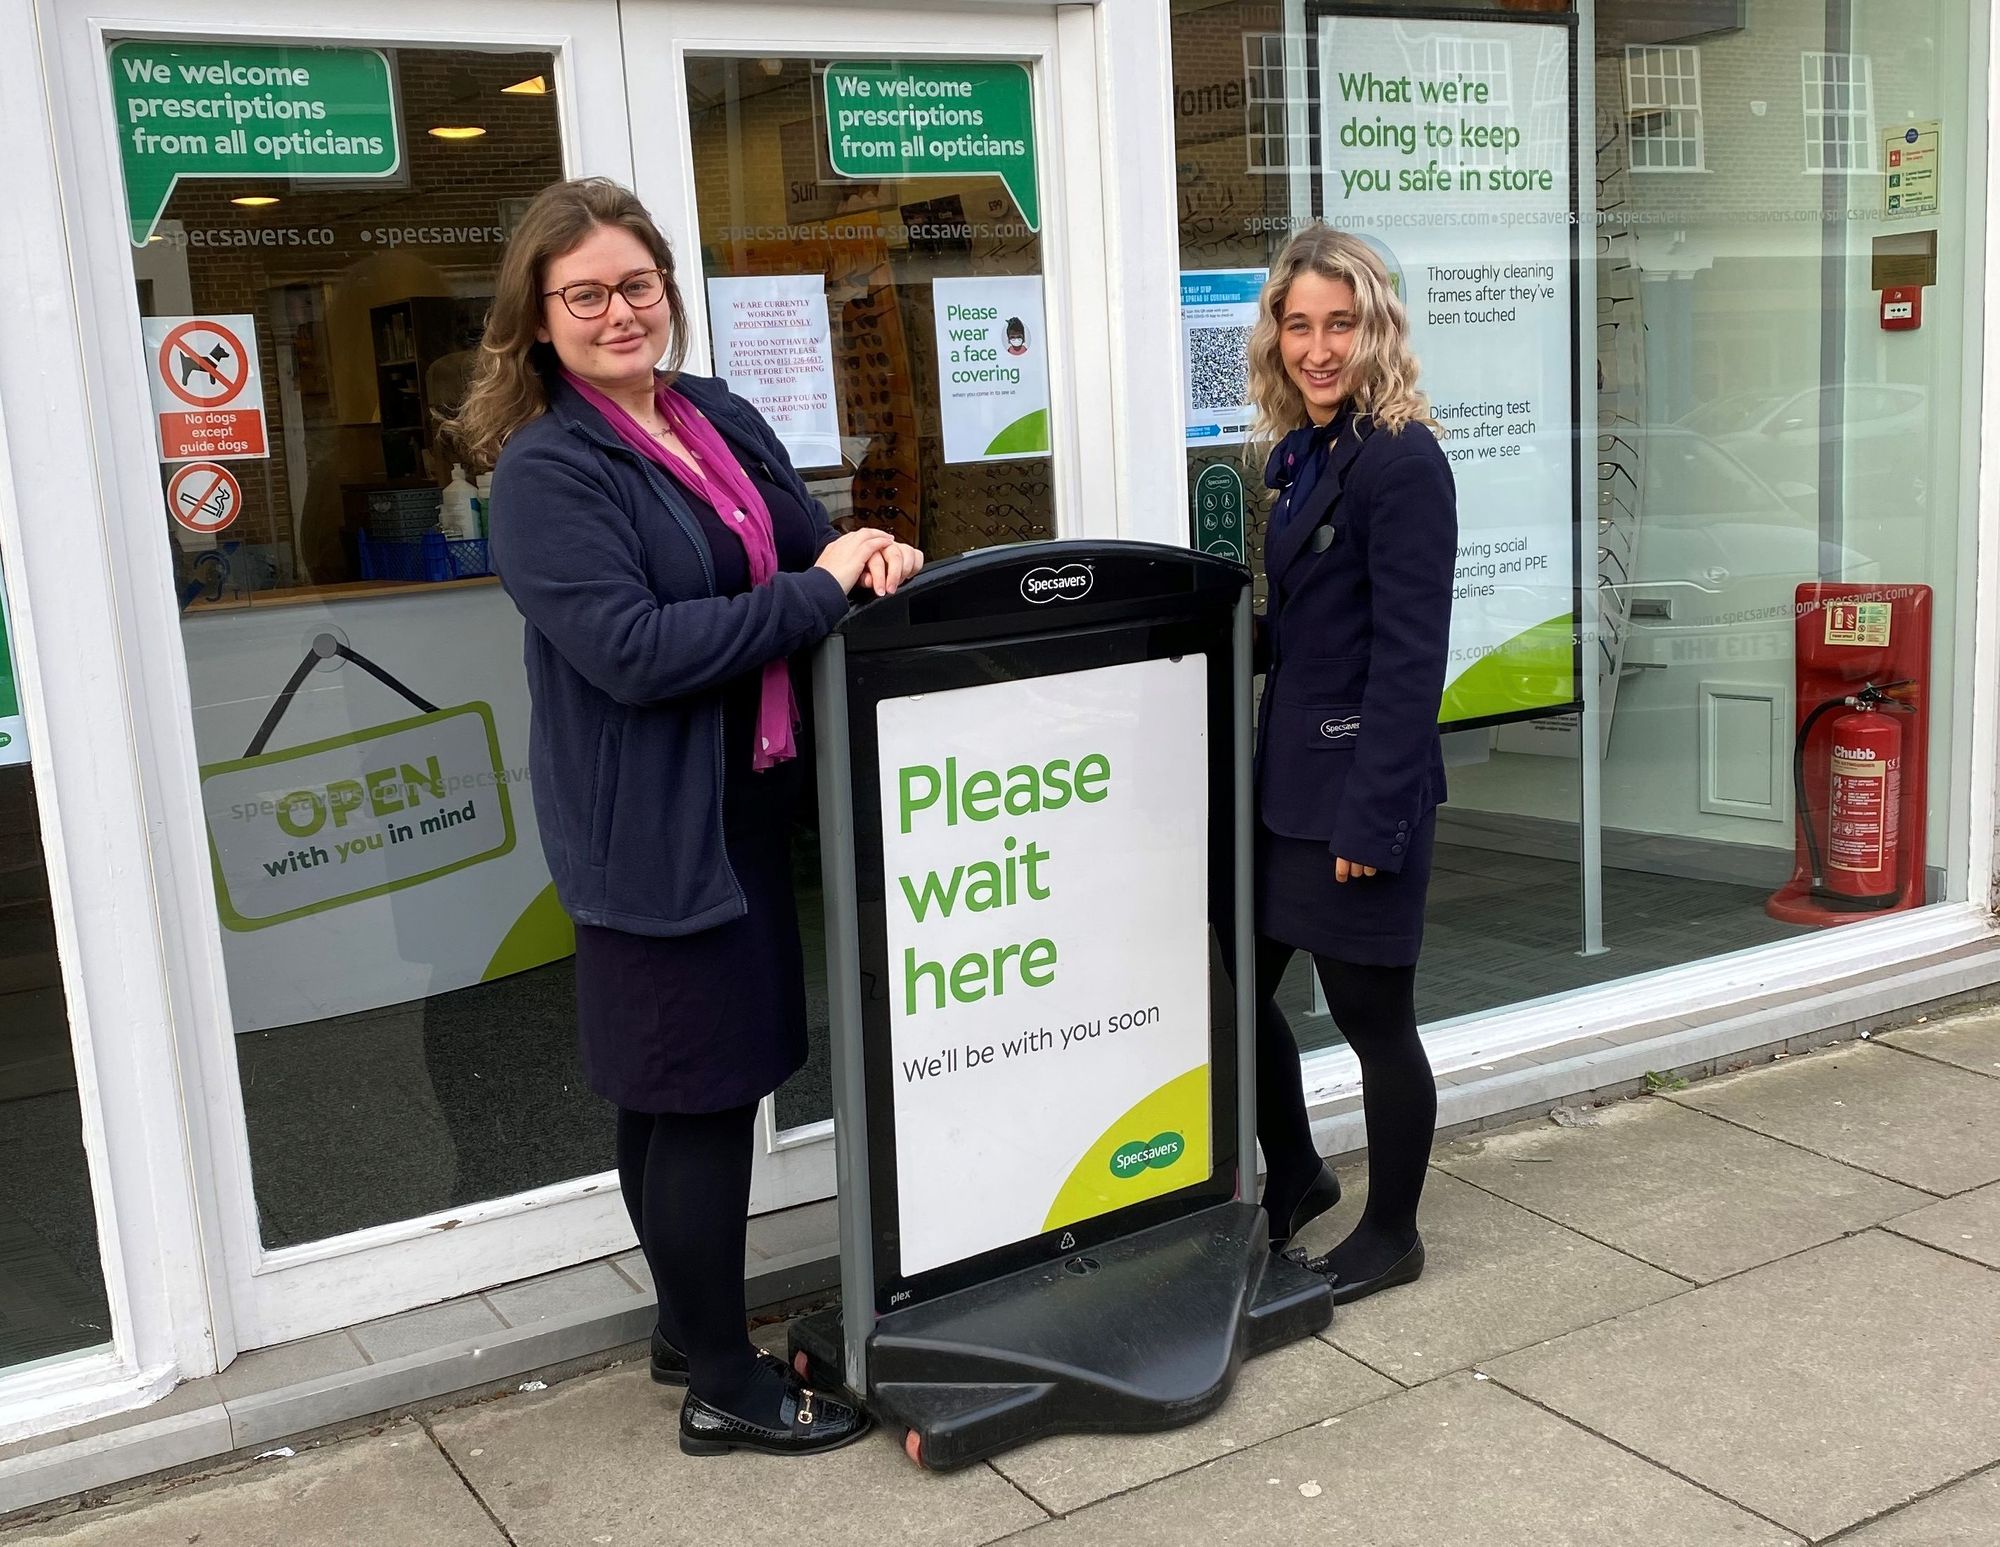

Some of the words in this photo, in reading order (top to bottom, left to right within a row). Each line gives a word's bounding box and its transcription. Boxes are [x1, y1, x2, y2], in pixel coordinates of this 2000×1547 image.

[122, 58, 171, 84] We
[178, 59, 310, 87] welcome
[835, 76, 871, 97] We
[876, 76, 972, 98] welcome
[1175, 76, 1258, 118] omen
[1338, 72, 1412, 104] What
[1418, 73, 1489, 104] we're
[127, 92, 326, 125] prescriptions
[838, 104, 984, 131] prescriptions
[132, 127, 208, 156] from
[214, 128, 248, 155] all
[254, 129, 384, 160] opticians
[1339, 116, 1417, 155] doing
[1423, 120, 1453, 150] to
[1459, 118, 1520, 155] keep
[841, 136, 896, 159] from
[900, 136, 925, 158] all
[929, 134, 1026, 161] opticians
[1340, 166, 1392, 199] you
[1398, 160, 1452, 192] safe
[1459, 161, 1482, 192] in
[1488, 164, 1553, 192] store
[791, 181, 818, 204] Sun
[1376, 211, 1491, 231] specsavers.com
[718, 223, 874, 243] specsavers.com
[1427, 264, 1500, 283] Thoroughly
[1503, 263, 1554, 280] cleaning
[1427, 287, 1472, 303] frames
[1475, 285, 1506, 301] after
[1509, 283, 1555, 302] they've
[733, 302, 746, 310] WE
[747, 301, 763, 309] ARE
[764, 299, 810, 308] CURRENTLY
[747, 310, 785, 318] WORKING
[787, 309, 797, 317] BY
[947, 304, 998, 321] Please
[734, 320, 788, 329] APPOINTMENT
[1428, 309, 1461, 325] been
[1463, 306, 1516, 324] touched
[739, 340, 756, 348] YOU
[757, 339, 769, 347] DO
[770, 338, 786, 346] NOT
[808, 337, 820, 345] AN
[949, 328, 989, 342] wear
[733, 349, 789, 357] APPOINTMENT
[790, 347, 817, 355] PLEASE
[764, 358, 775, 366] ON
[950, 350, 960, 362] a
[963, 345, 998, 362] face
[730, 368, 752, 376] FIRST
[753, 367, 783, 376] BEFORE
[785, 365, 825, 374] ENTERING
[952, 365, 1020, 384] covering
[761, 396, 771, 404] TO
[772, 395, 794, 403] KEEP
[794, 394, 810, 402] YOU
[811, 393, 828, 401] AND
[777, 403, 810, 412] AROUND
[811, 402, 828, 410] YOU
[185, 414, 203, 425] No
[206, 412, 237, 427] dogs
[1430, 403, 1503, 419] Disinfecting
[1506, 400, 1531, 414] test
[192, 426, 234, 441] except
[1473, 422, 1504, 438] after
[1507, 419, 1536, 436] each
[180, 441, 215, 455] guide
[217, 440, 249, 454] dogs
[1446, 448, 1474, 461] rson
[1478, 446, 1496, 459] we
[1500, 444, 1520, 457] see
[1207, 477, 1231, 488] Specsavers
[1456, 541, 1491, 558] owing
[1494, 536, 1527, 554] social
[1455, 562, 1496, 579] ancing
[1499, 557, 1522, 574] and
[1525, 555, 1548, 571] PPE
[1027, 573, 1086, 594] Specsavers
[1452, 583, 1495, 600] delines
[1834, 745, 1876, 760] Chubb
[437, 766, 531, 796] specsave
[275, 755, 446, 838] OPEN
[899, 753, 1111, 834] Please
[262, 846, 330, 878] with
[334, 832, 384, 864] you
[387, 823, 414, 844] in
[420, 800, 477, 835] mind
[898, 836, 1051, 923] wait
[904, 937, 1057, 1016] here
[902, 1048, 957, 1083] We'll
[965, 1042, 994, 1070] be
[1002, 1027, 1053, 1059] with
[1060, 1019, 1101, 1050] you
[1108, 1005, 1160, 1034] soon
[1116, 1141, 1178, 1171] Specsavers
[890, 1290, 911, 1305] plex
